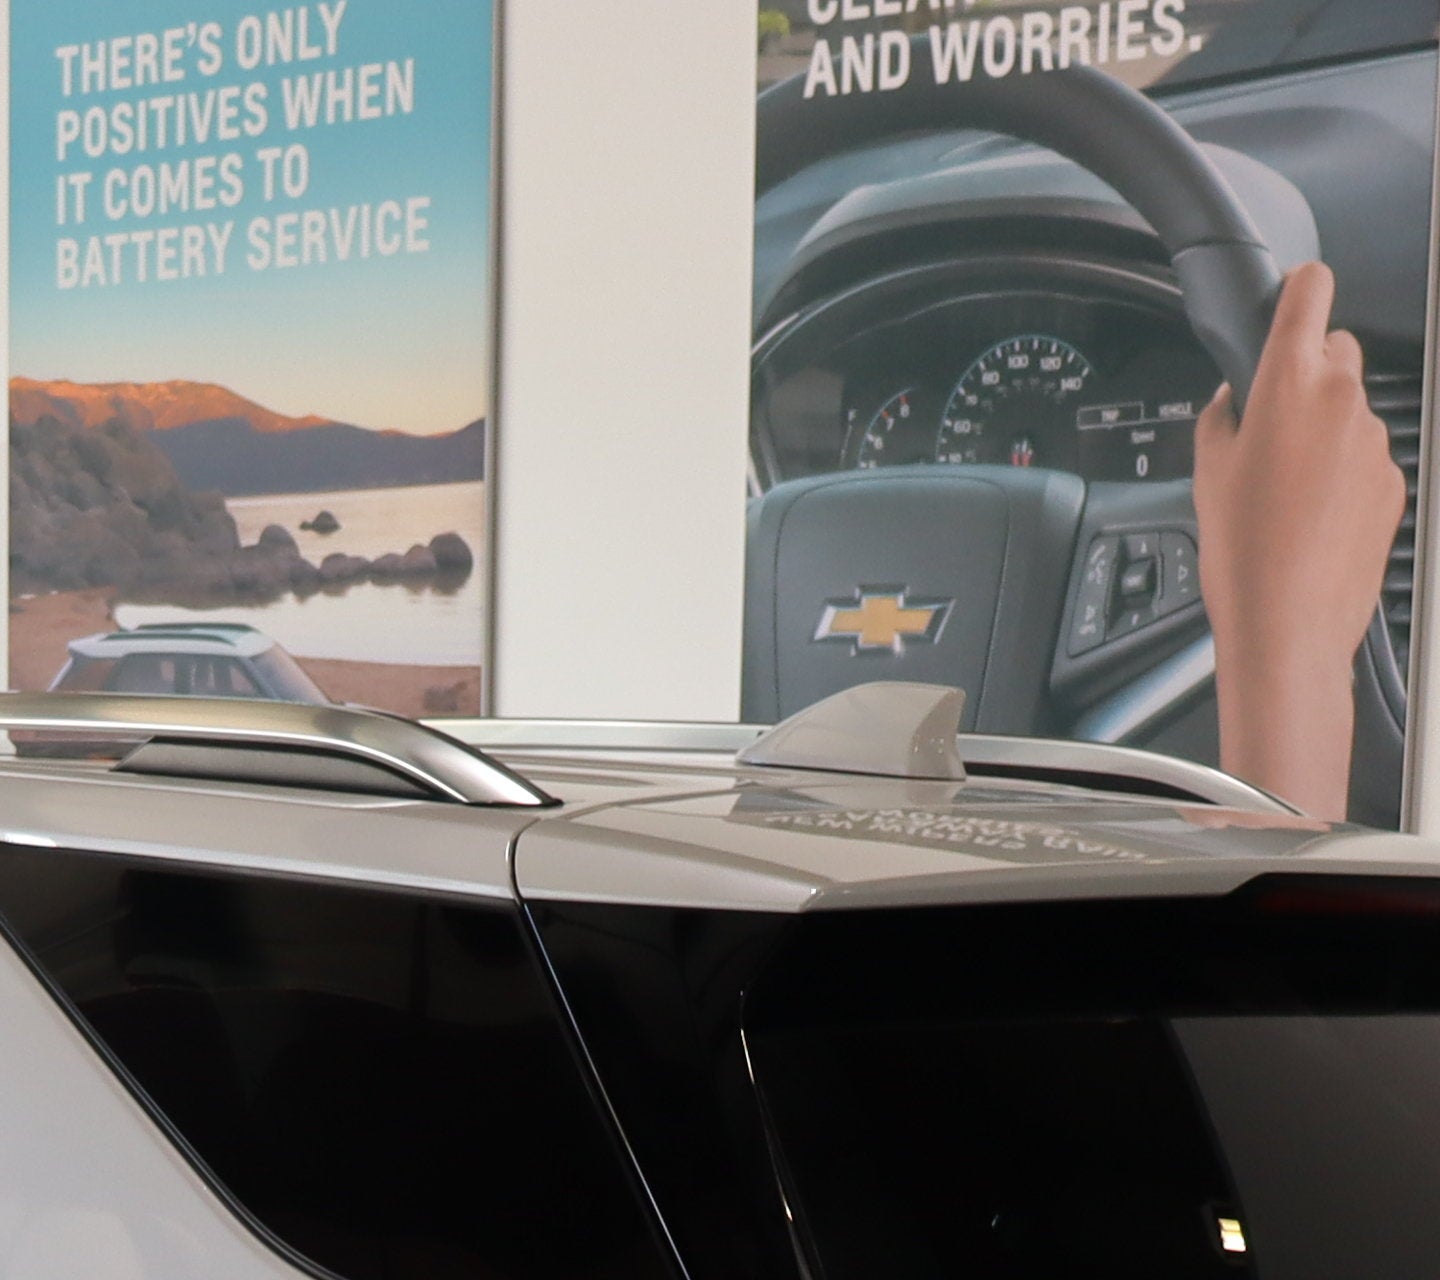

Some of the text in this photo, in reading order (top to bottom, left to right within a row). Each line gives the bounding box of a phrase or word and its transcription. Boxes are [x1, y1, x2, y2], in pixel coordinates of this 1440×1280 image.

[55, 0, 347, 96] THERE'S ONLY
[802, 0, 1204, 98] AND WORRIES.
[56, 58, 414, 161] POSITIVES WHEN
[56, 143, 309, 225] IT COMES TO
[56, 196, 431, 289] BATTERY SERVICE
